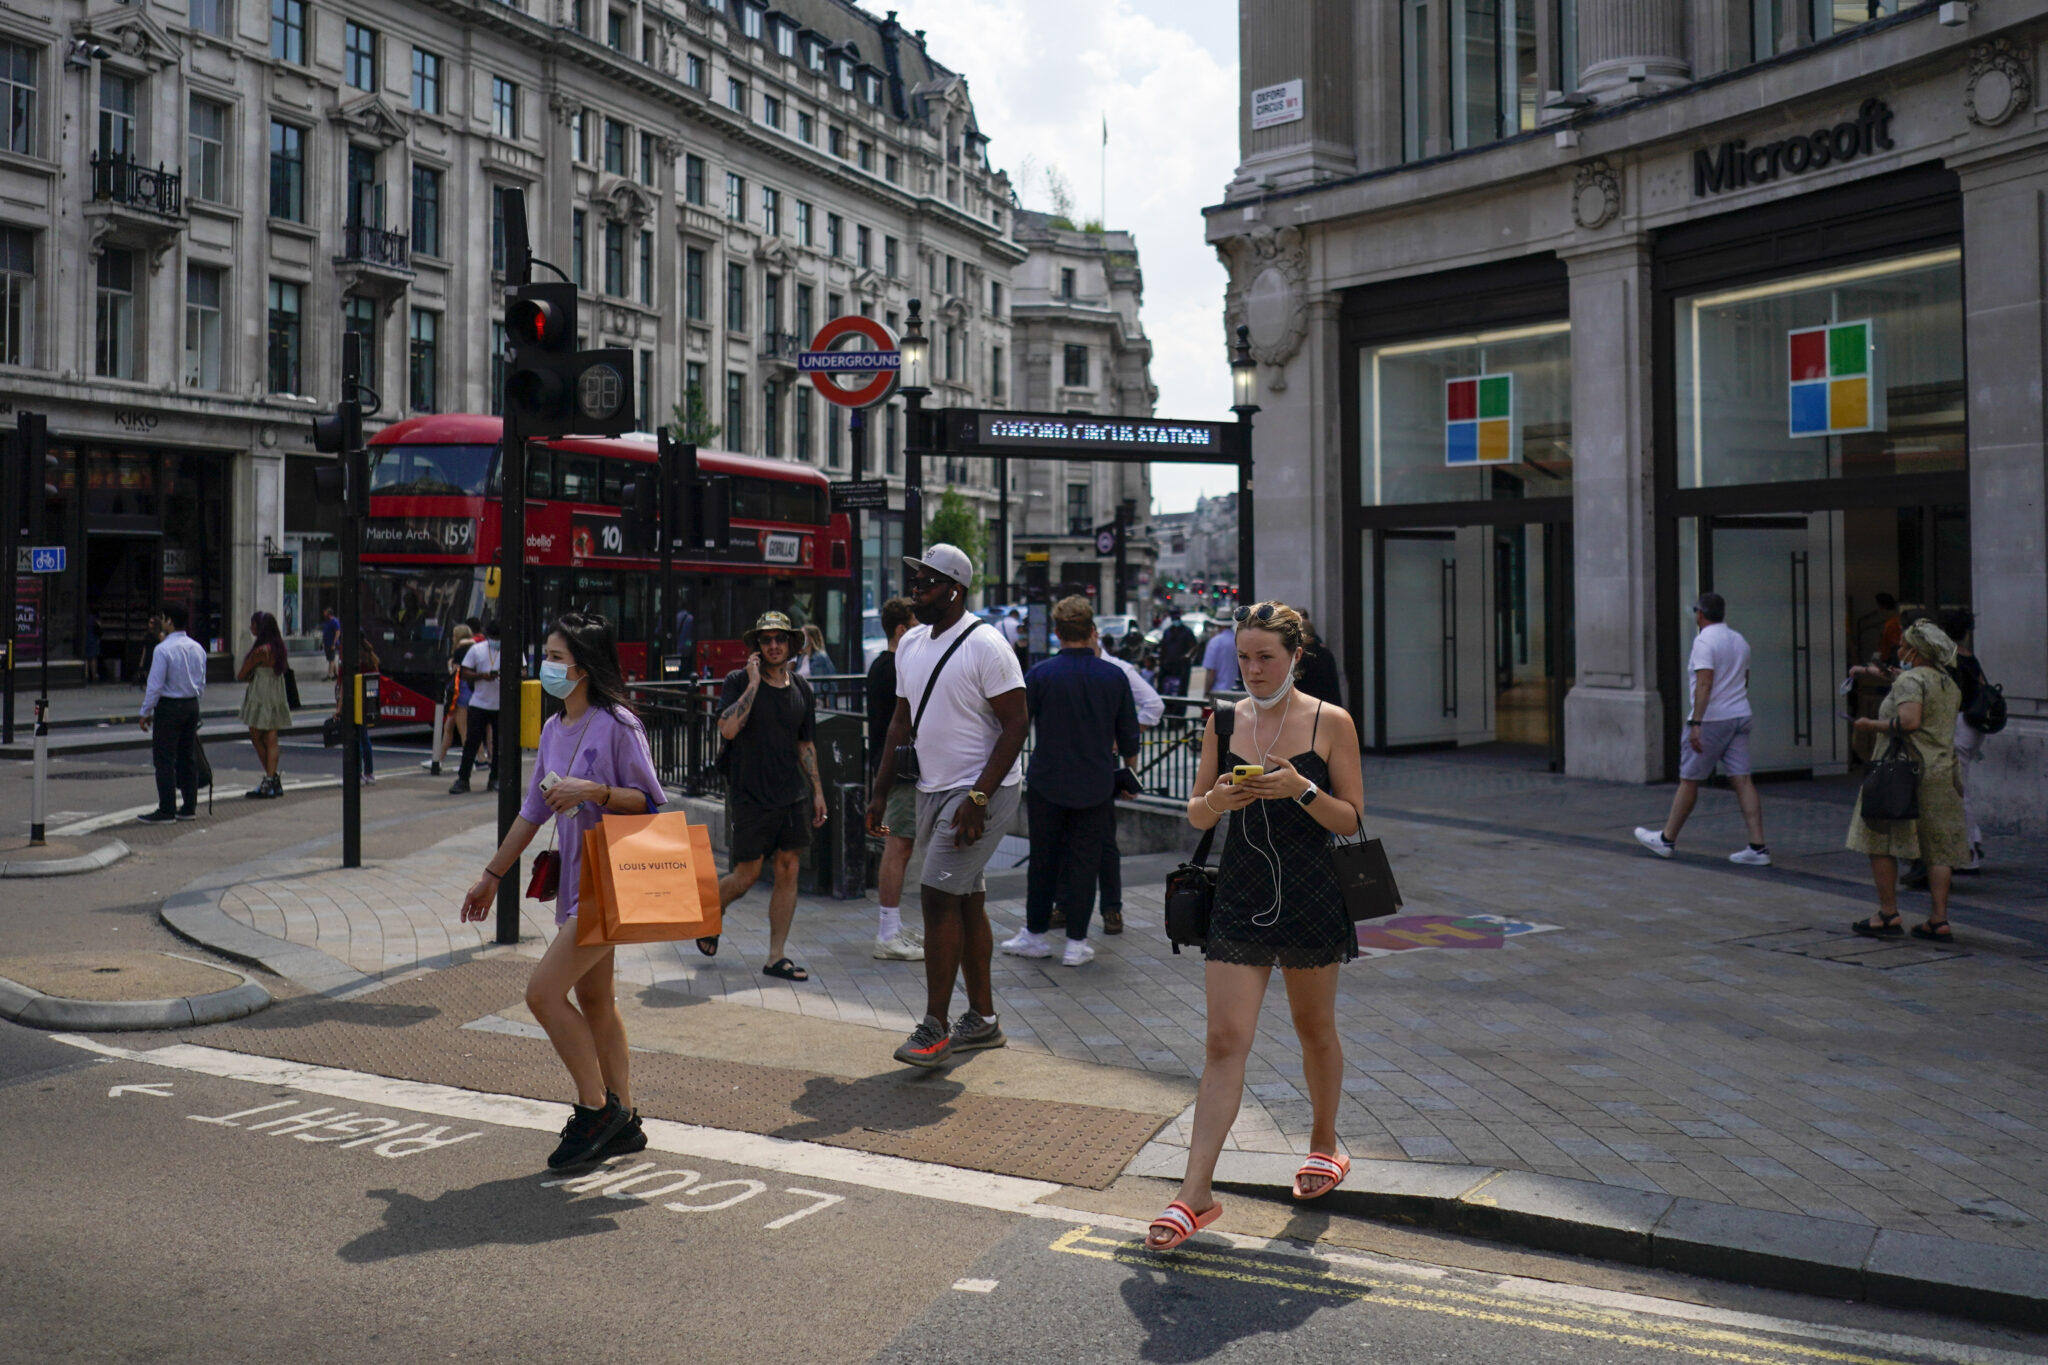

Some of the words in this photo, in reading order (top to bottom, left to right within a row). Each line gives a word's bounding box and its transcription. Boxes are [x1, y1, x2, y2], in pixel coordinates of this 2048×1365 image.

[1256, 88, 1286, 103] OXFORD
[1256, 100, 1284, 115] CIRCUS
[1693, 97, 1895, 197] Microsoft
[802, 355, 900, 368] UNDERGROUND
[114, 410, 159, 428] KIKO
[991, 420, 1069, 439] OXFORD
[1071, 424, 1134, 441] CIRCUS
[1138, 426, 1210, 445] STATION
[366, 527, 402, 541] Marble
[406, 528, 430, 540] Arch
[444, 525, 470, 546] 159
[768, 541, 796, 557] GORILLAS
[619, 863, 646, 871] LOUIS
[648, 862, 687, 870] VUITTON
[186, 1100, 484, 1158] RIGHT
